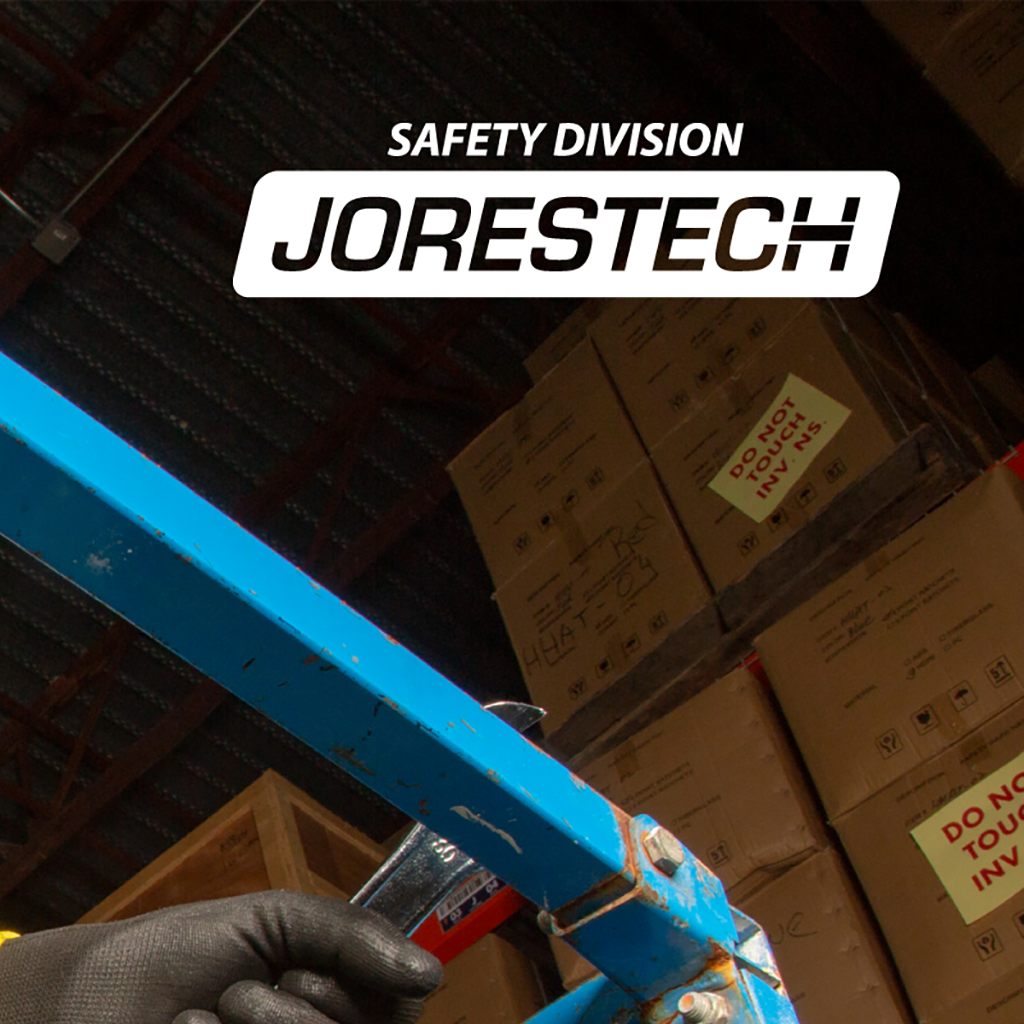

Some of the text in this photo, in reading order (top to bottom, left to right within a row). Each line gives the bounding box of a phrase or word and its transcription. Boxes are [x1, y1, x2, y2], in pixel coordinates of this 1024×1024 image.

[730, 397, 795, 480] DO NOT
[746, 412, 805, 483] TOUCH
[941, 806, 984, 844] DO
